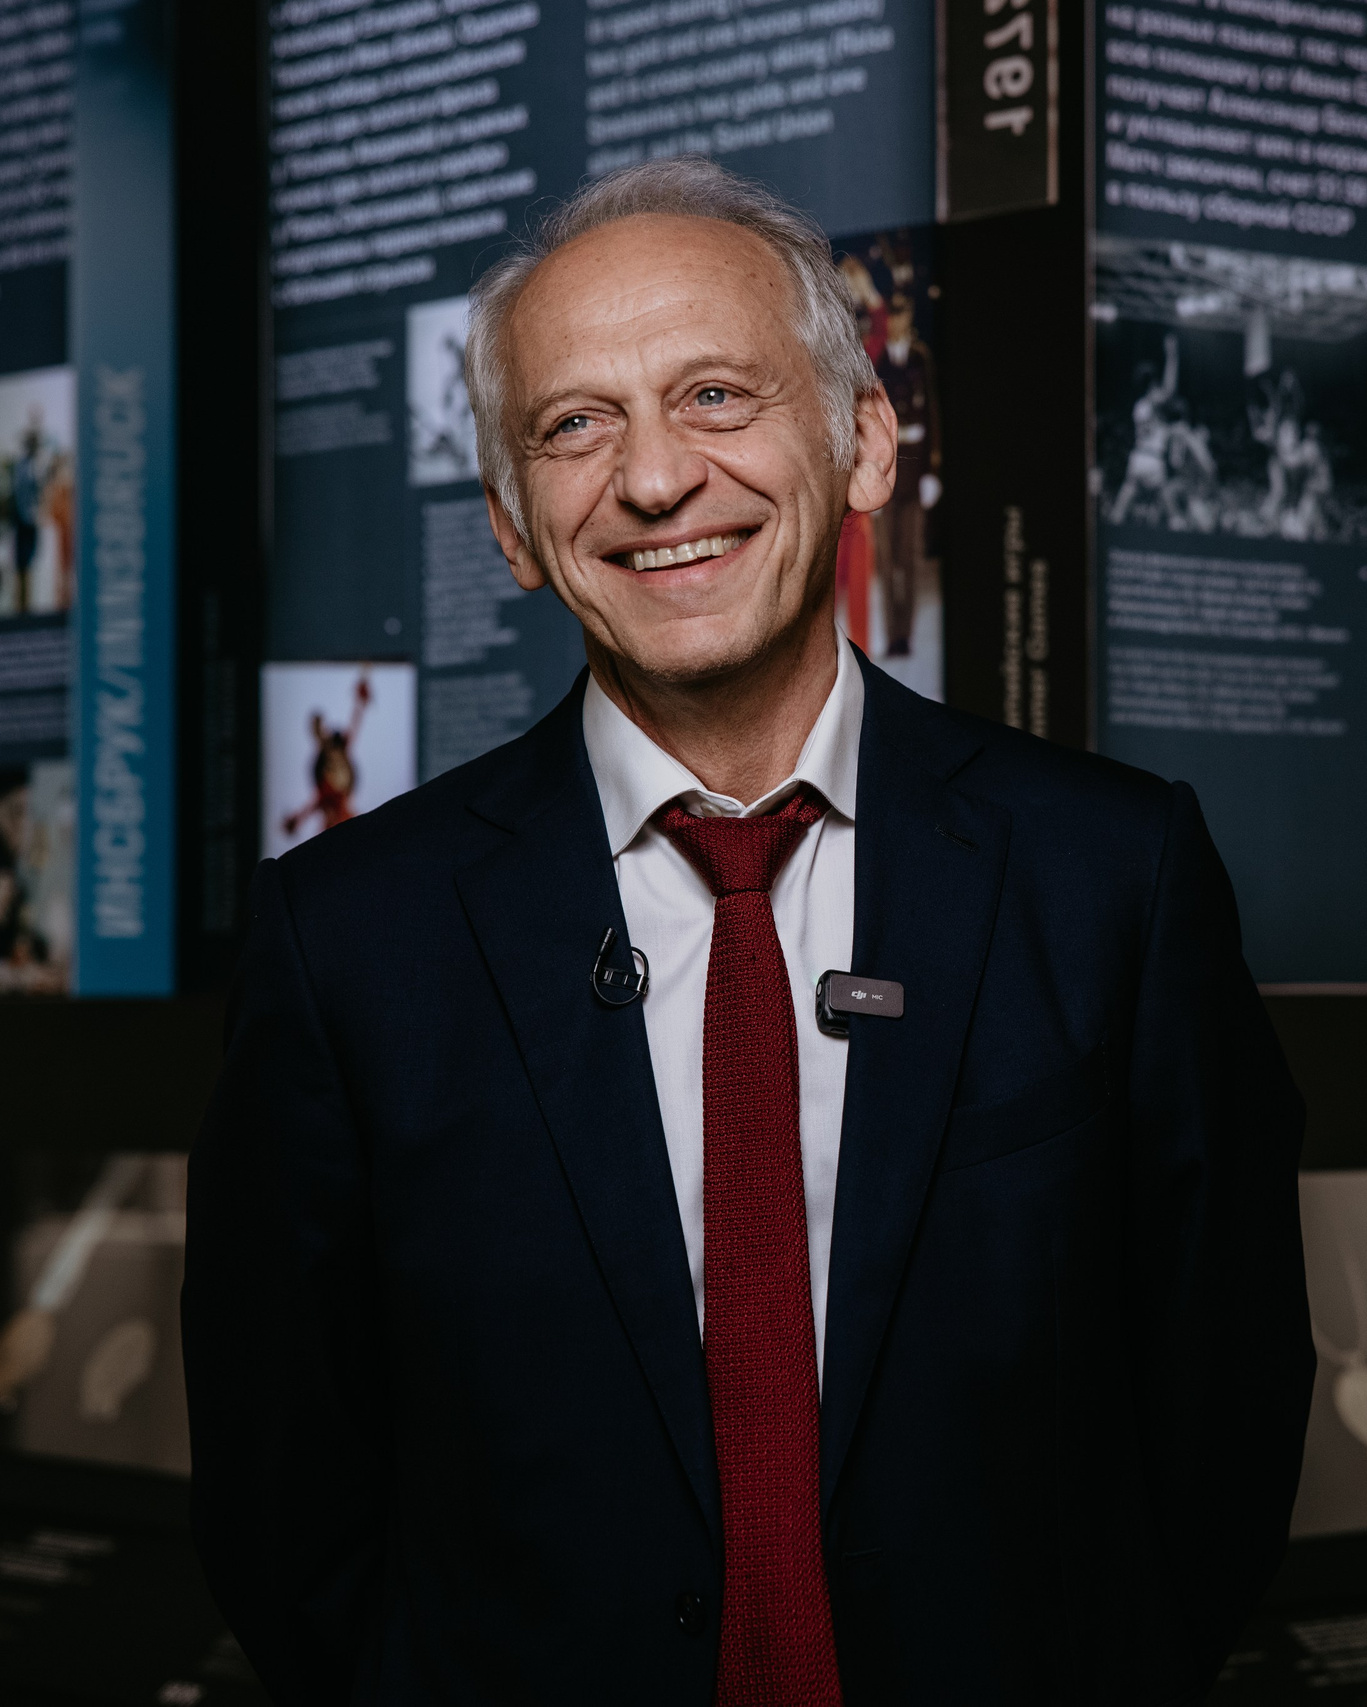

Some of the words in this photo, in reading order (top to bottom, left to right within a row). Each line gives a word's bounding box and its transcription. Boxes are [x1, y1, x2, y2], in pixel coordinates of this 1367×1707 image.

[1137, 9, 1217, 42] разных
[1107, 76, 1206, 109] получает
[1209, 88, 1322, 134] Александр
[715, 117, 773, 152] Soviet
[773, 109, 832, 139] Union
[1124, 114, 1253, 152] укладывает
[1256, 135, 1295, 159] мяч
[1107, 142, 1162, 174] Матч
[1125, 185, 1201, 220] пользу
[1204, 194, 1294, 227] сборной
[1294, 204, 1354, 234] СССР
[871, 993, 884, 1001] MIC
